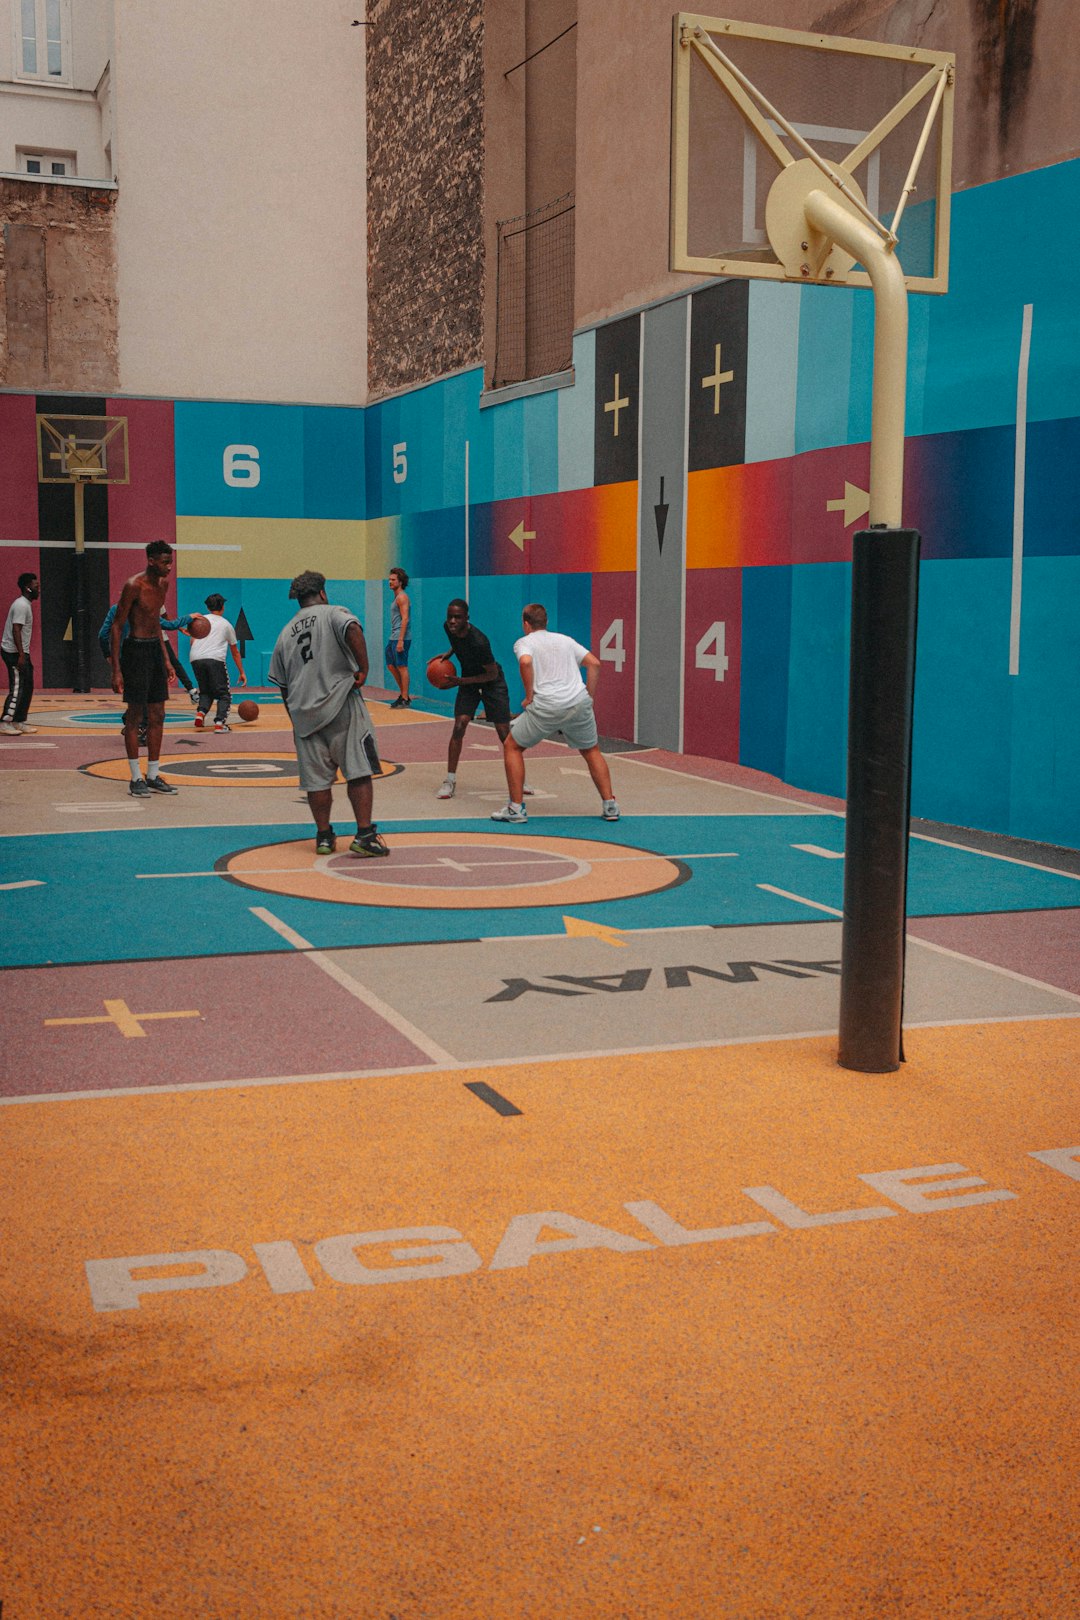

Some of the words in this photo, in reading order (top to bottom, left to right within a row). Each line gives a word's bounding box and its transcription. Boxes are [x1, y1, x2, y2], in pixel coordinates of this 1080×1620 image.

[223, 444, 261, 488] 6
[392, 441, 408, 484] 5
[290, 615, 317, 638] JETER
[297, 631, 314, 665] 2
[599, 618, 626, 673] 4
[695, 621, 729, 682] 4
[84, 1161, 1019, 1313] PIGALLE
